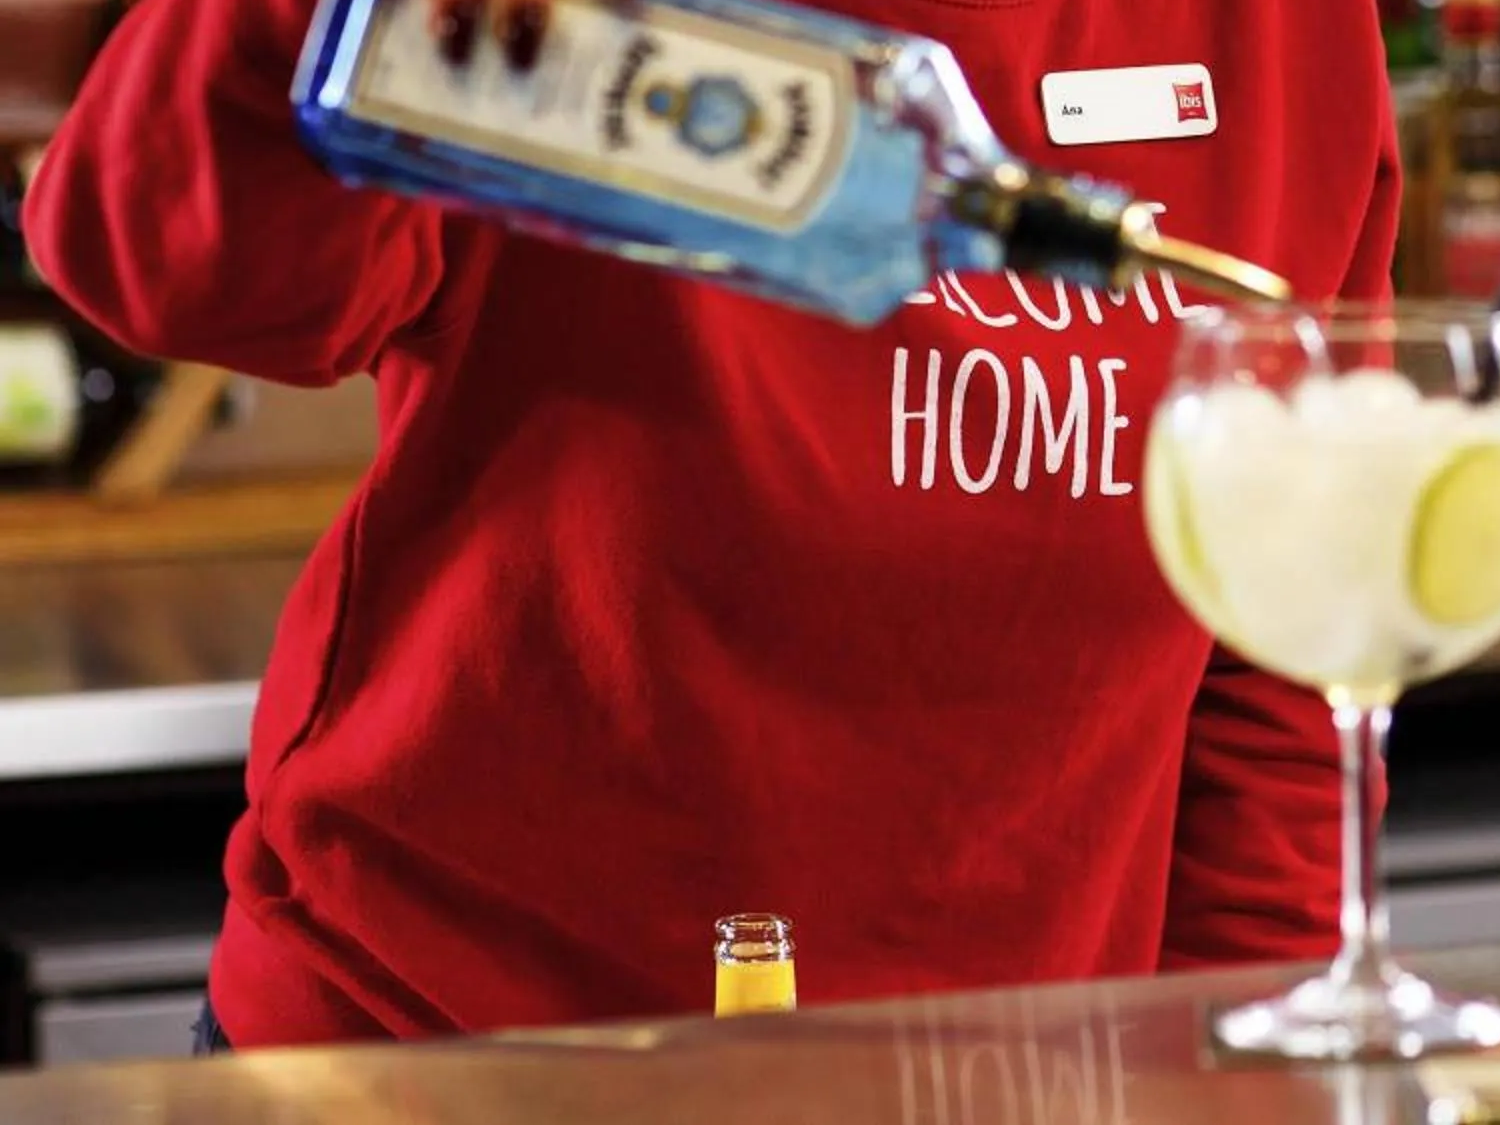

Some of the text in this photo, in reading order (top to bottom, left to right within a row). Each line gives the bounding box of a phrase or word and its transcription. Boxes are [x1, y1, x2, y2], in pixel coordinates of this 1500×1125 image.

[1180, 93, 1202, 108] ibis
[1061, 104, 1083, 116] Ana
[891, 347, 1133, 499] HOME
